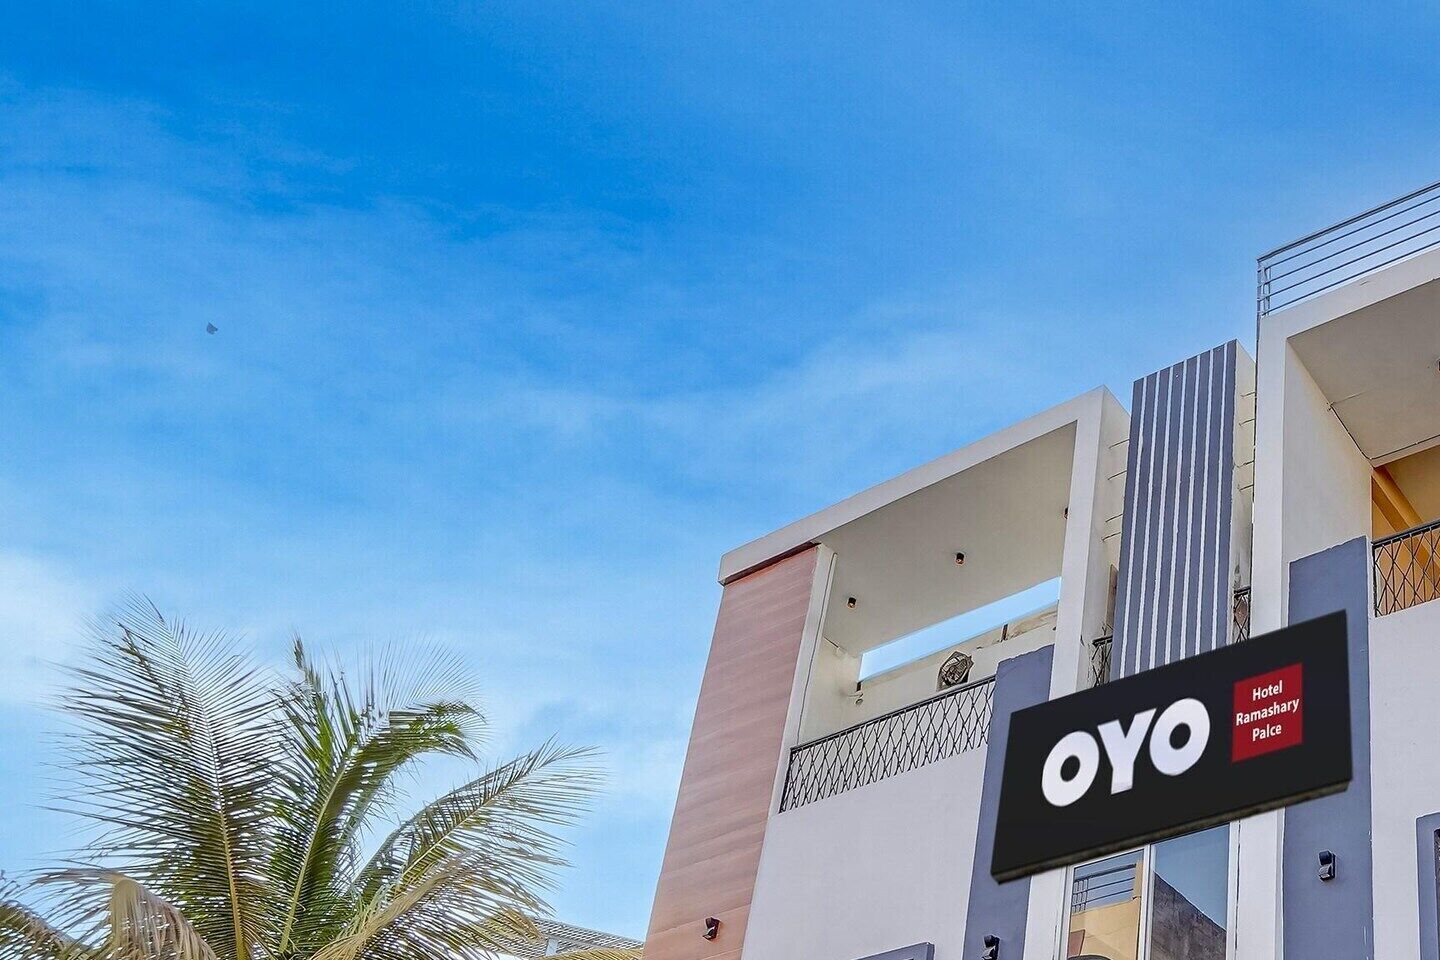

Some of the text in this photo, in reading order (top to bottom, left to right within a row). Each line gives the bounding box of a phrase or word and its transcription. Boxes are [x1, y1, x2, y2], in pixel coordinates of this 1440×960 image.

[1252, 679, 1282, 701] Hotel
[1235, 697, 1300, 726] Ramashary
[1251, 723, 1282, 742] Palce
[1042, 698, 1210, 806] OYO
